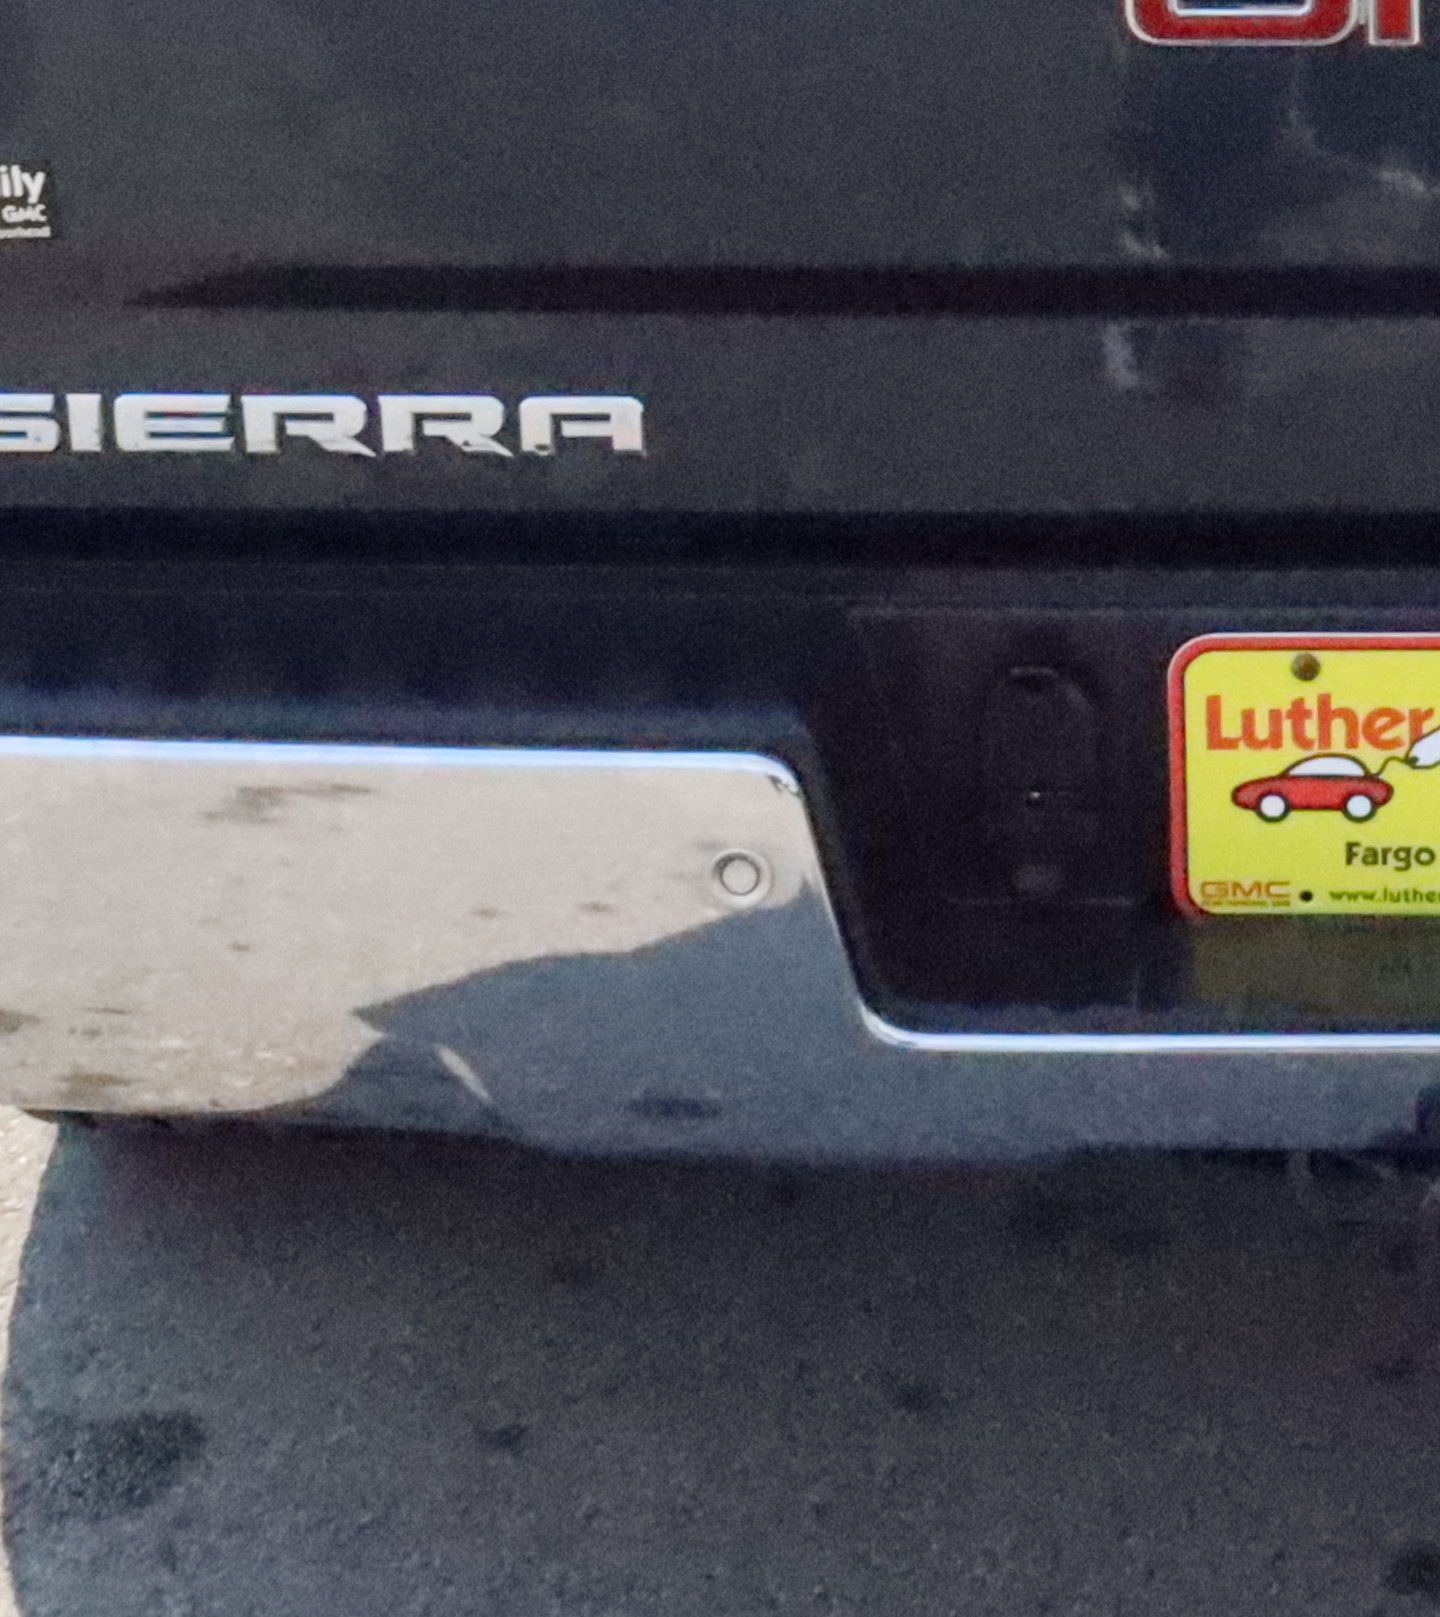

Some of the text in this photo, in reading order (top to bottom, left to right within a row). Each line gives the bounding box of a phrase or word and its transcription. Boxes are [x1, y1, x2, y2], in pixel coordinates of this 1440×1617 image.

[1, 204, 47, 223] GMC
[1205, 694, 1435, 751] Luther
[1345, 842, 1436, 873] Fargo
[1201, 882, 1290, 897] GMC
